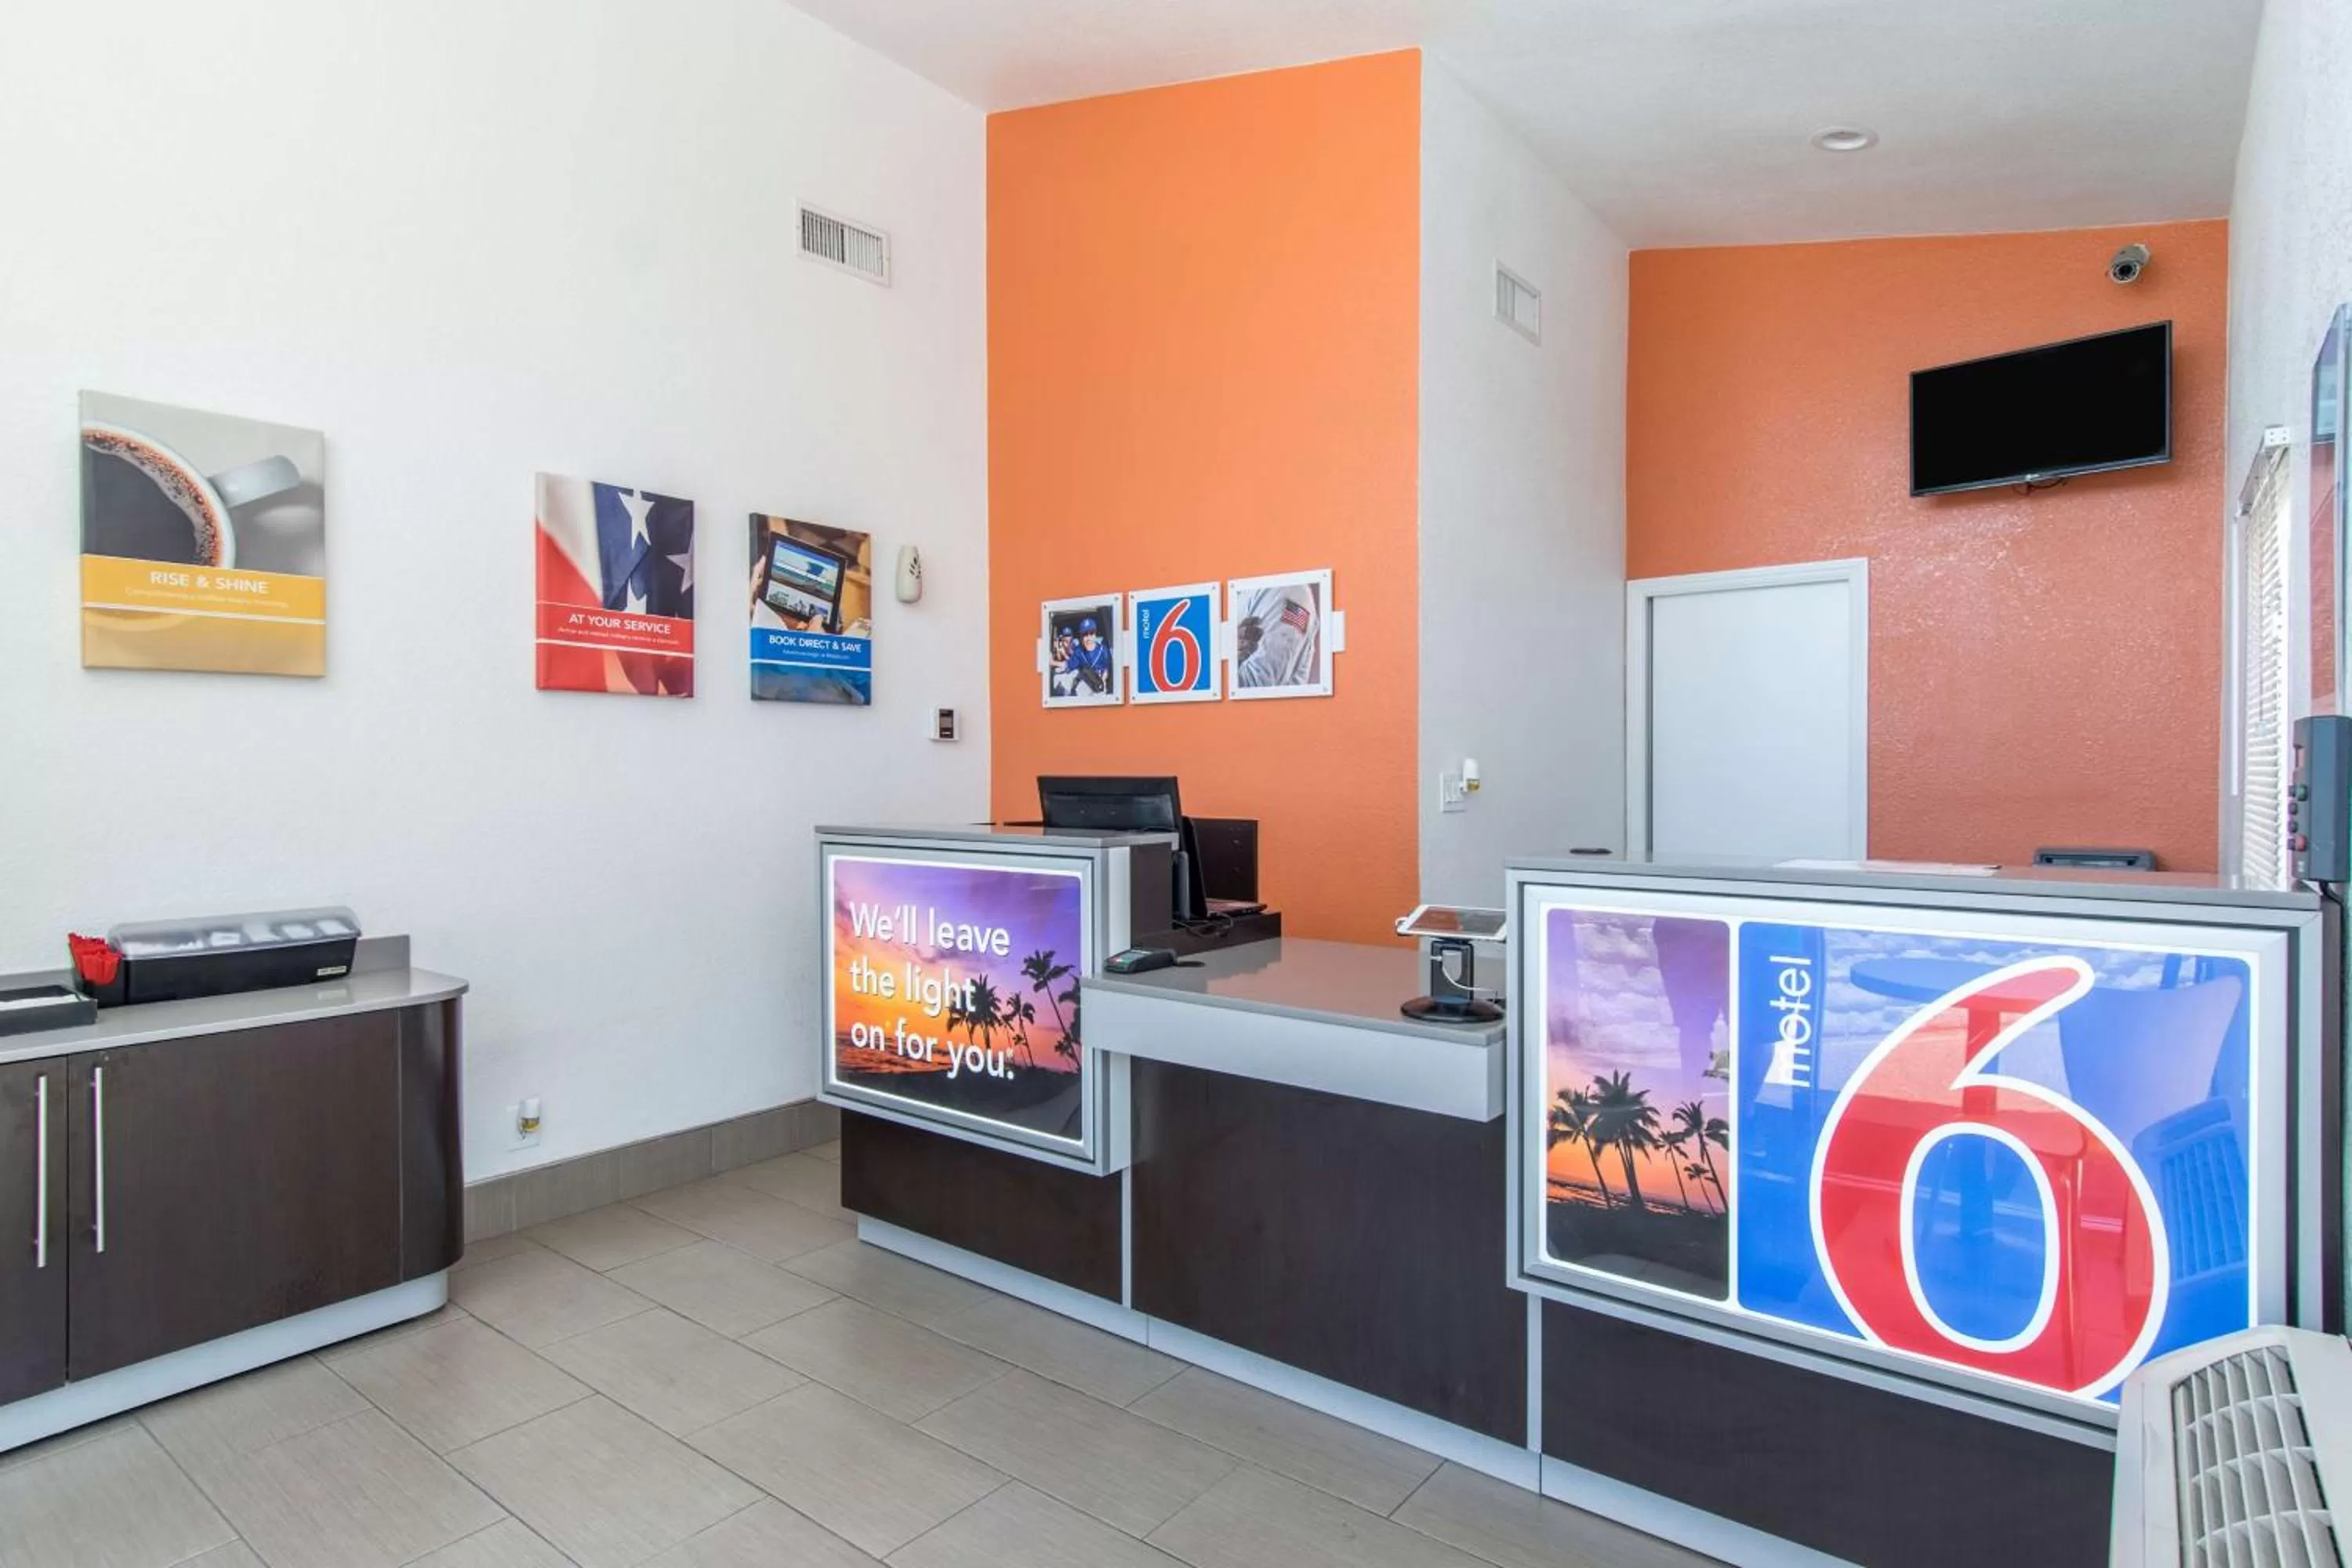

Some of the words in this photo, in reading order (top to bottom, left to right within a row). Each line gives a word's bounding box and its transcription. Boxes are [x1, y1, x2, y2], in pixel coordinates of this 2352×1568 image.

[151, 570, 189, 588] RISE
[196, 575, 209, 589] &
[215, 576, 270, 594] SHINE
[568, 614, 584, 625] AT
[588, 615, 620, 628] YOUR
[623, 619, 672, 634] SERVICE
[769, 634, 797, 646] BOOK
[799, 637, 831, 649] DIRECT
[832, 641, 840, 650] &
[841, 642, 862, 653] SAVE
[1149, 598, 1202, 693] 6
[849, 902, 917, 946] We'll
[929, 906, 1011, 956] leave
[849, 954, 896, 999] the
[906, 962, 976, 1018] light
[851, 1021, 885, 1052] on
[895, 1017, 938, 1062] for
[1769, 955, 1812, 1088] motel
[1809, 955, 2170, 1400] 6
